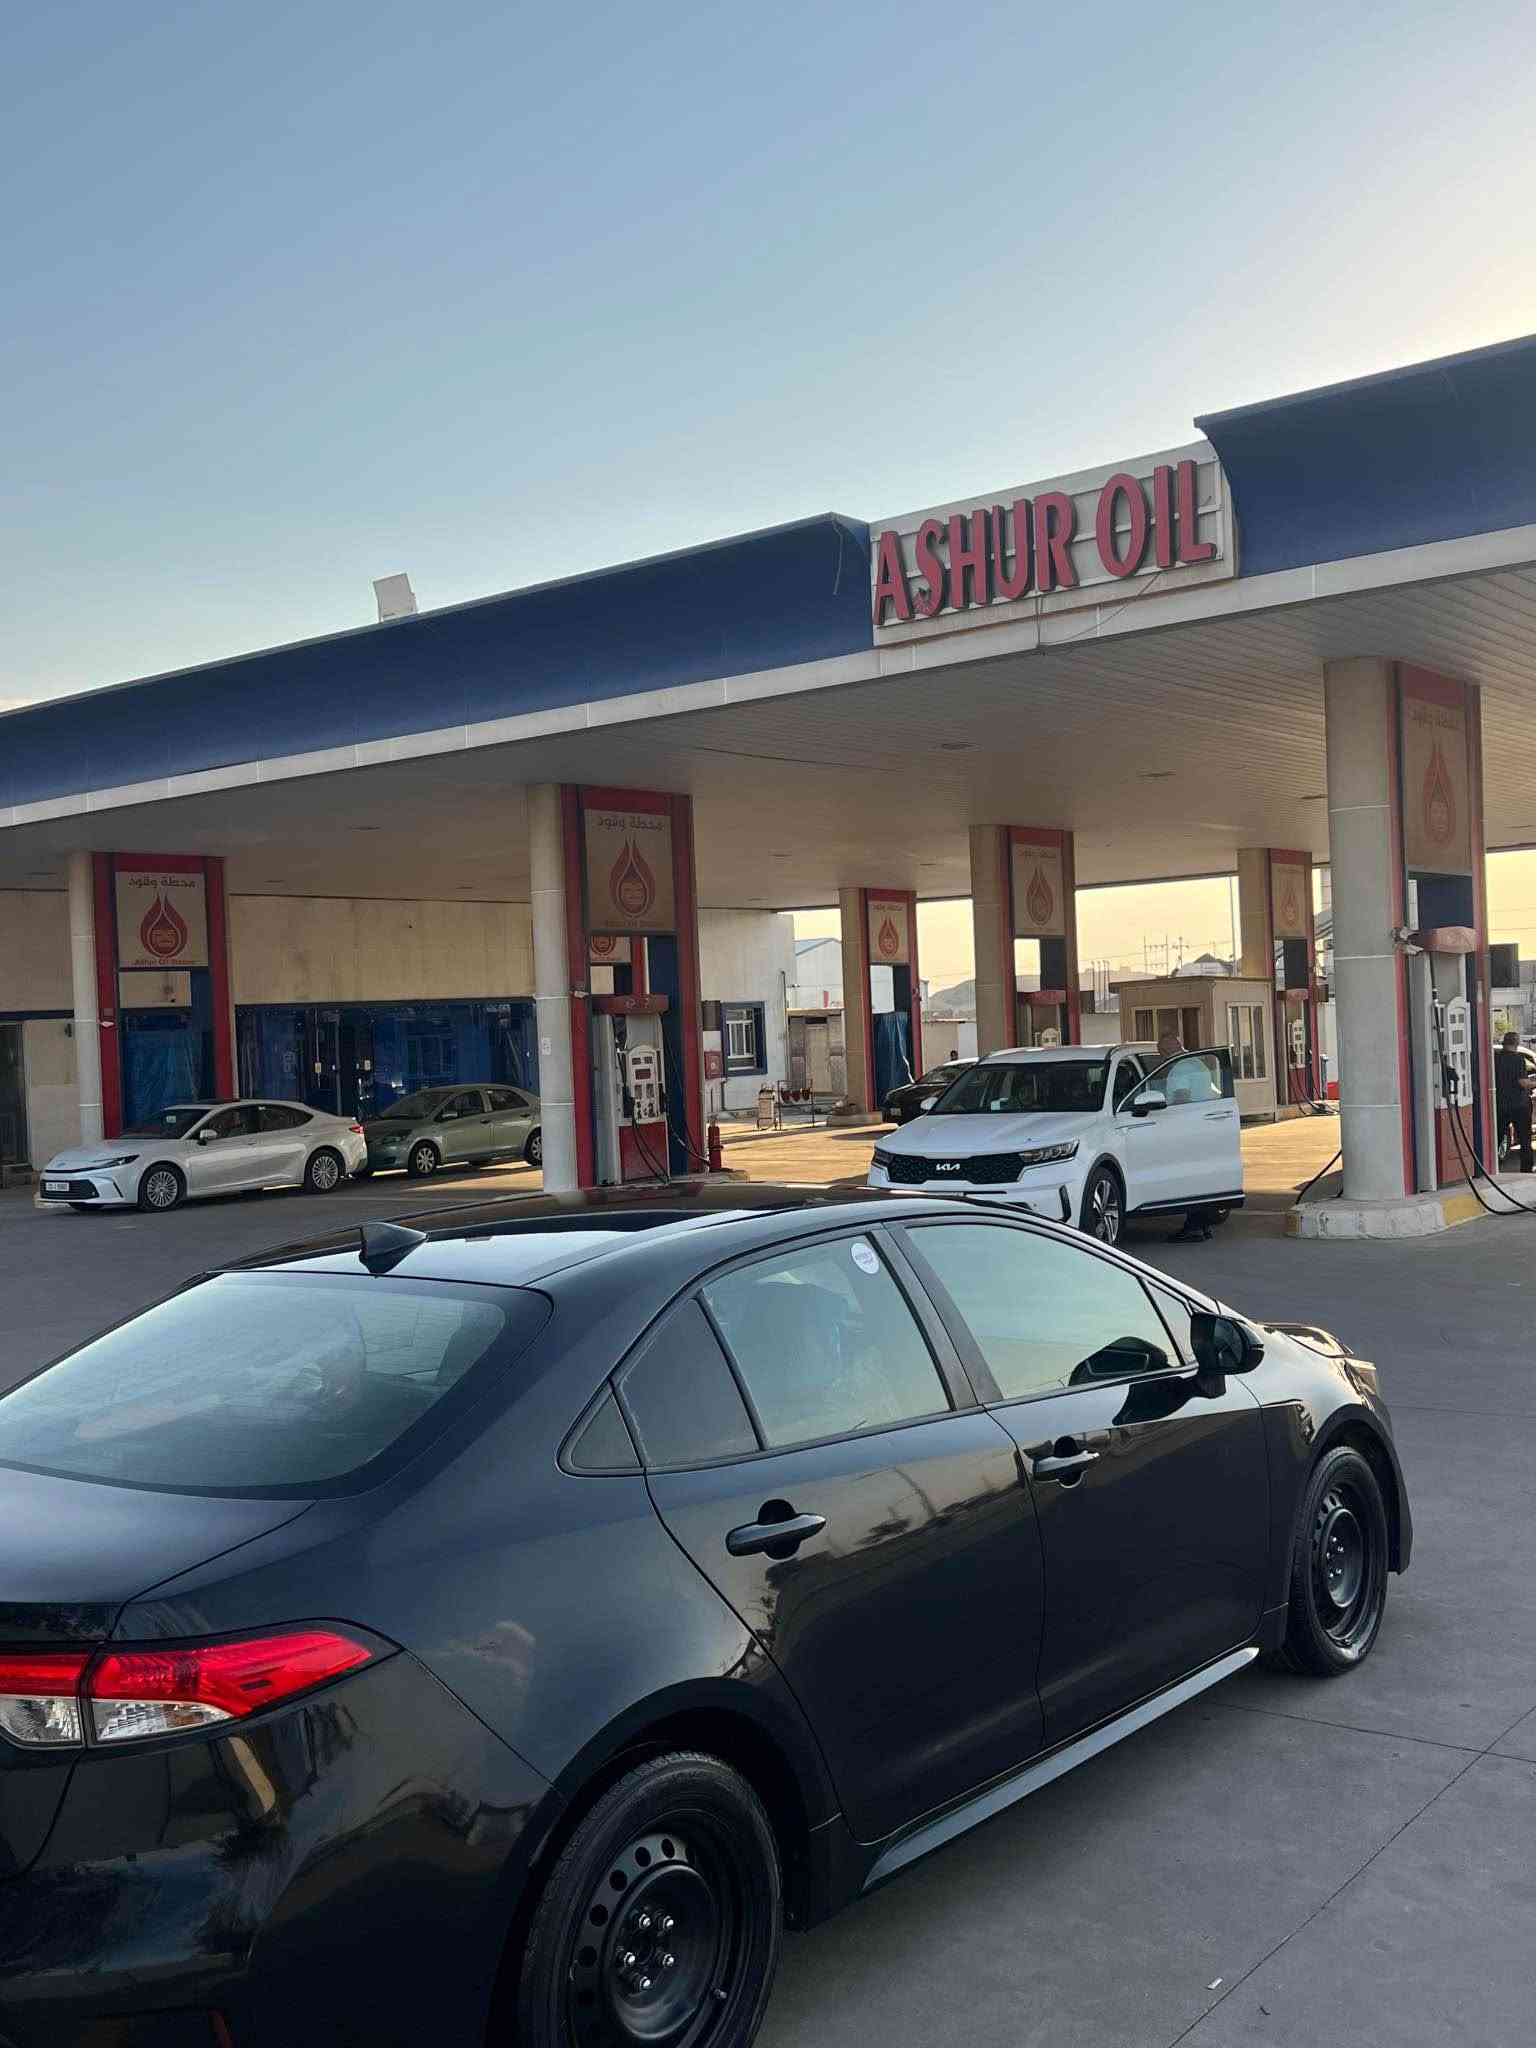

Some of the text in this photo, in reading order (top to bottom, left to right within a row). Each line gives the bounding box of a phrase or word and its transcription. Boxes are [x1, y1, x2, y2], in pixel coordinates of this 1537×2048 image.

[873, 459, 1217, 626] ASHUR OIL
[128, 875, 196, 888] محطة وقود
